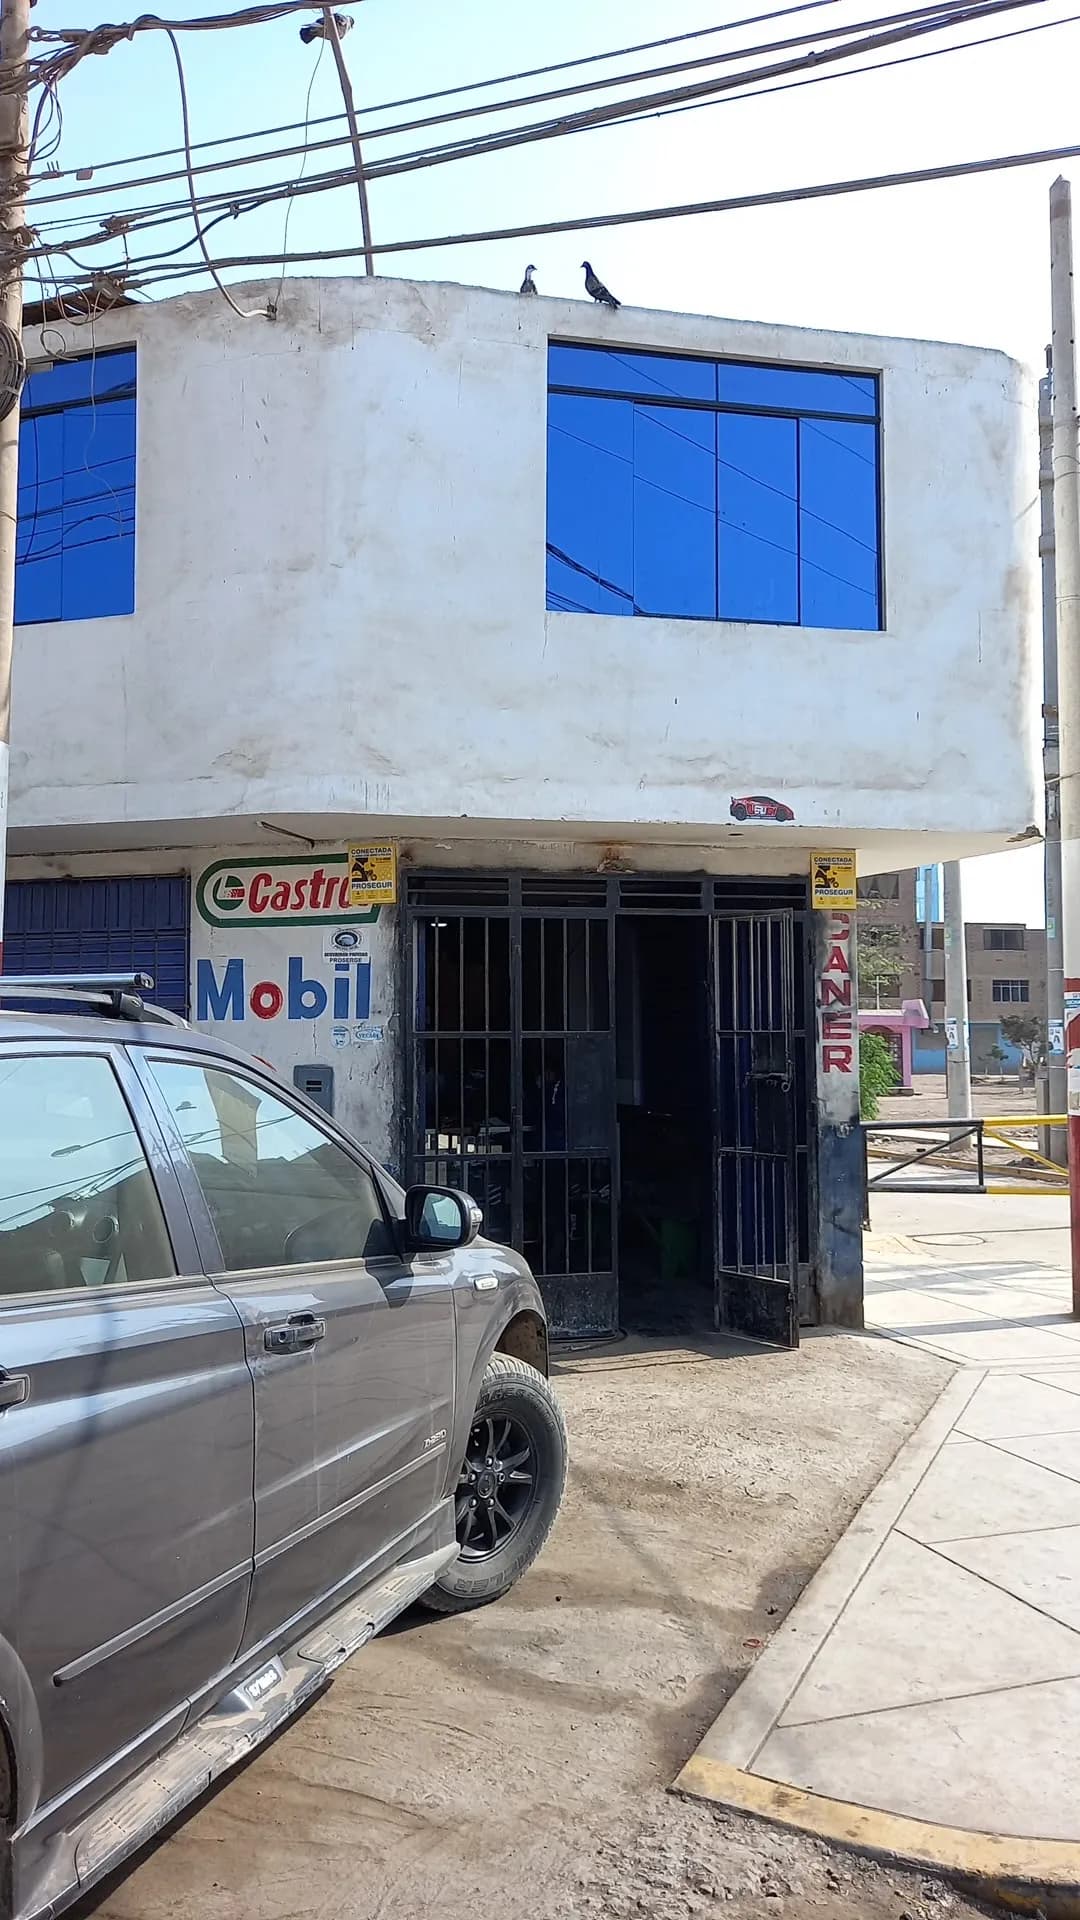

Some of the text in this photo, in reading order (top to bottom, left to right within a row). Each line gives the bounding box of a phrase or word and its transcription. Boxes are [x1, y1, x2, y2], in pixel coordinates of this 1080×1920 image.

[351, 847, 392, 855] CONECTADA
[351, 881, 392, 890] PROSEGUR
[814, 888, 854, 896] PROSEGUR
[196, 956, 372, 1022] Mobil
